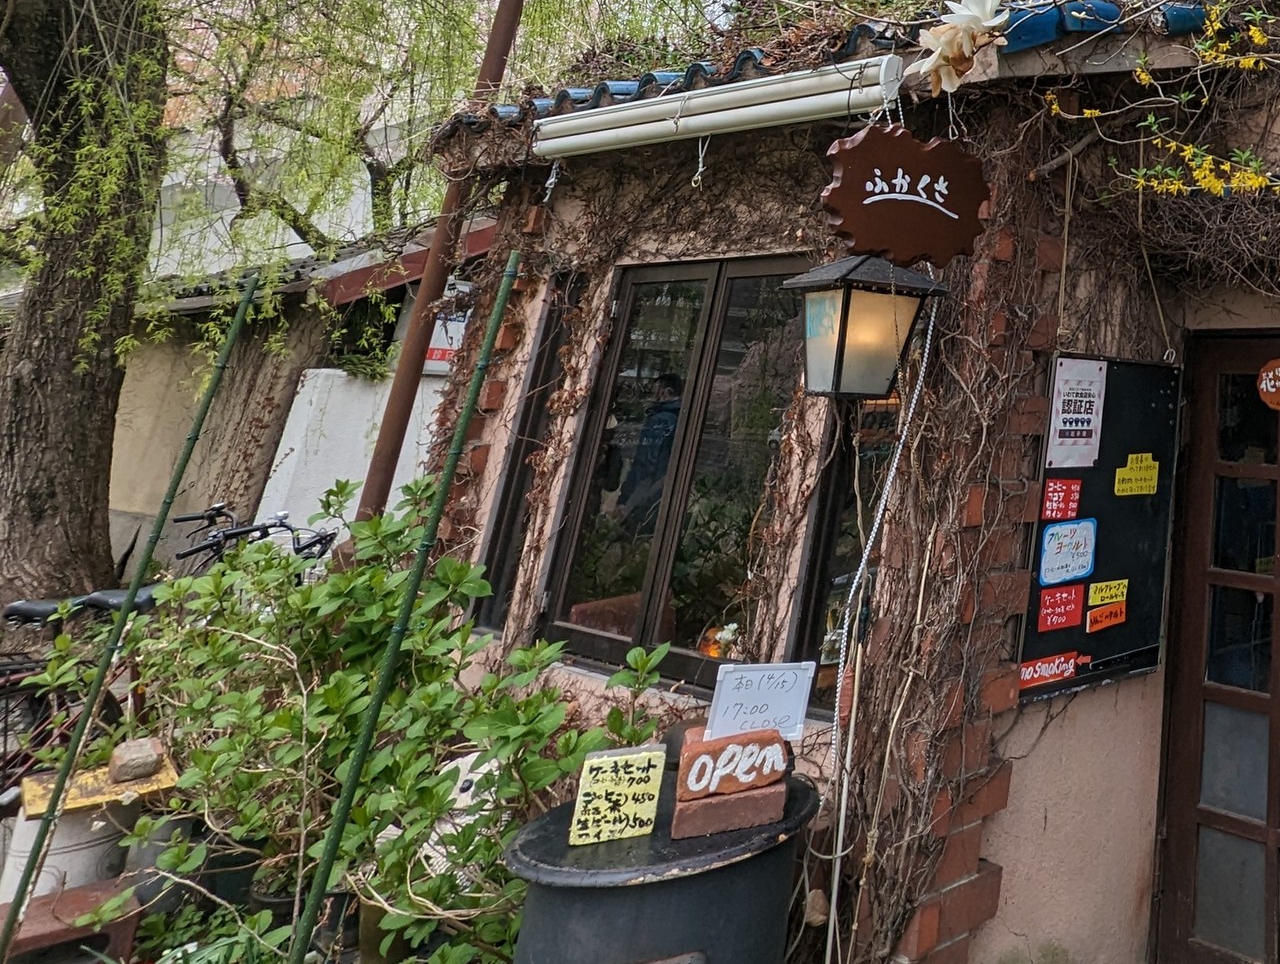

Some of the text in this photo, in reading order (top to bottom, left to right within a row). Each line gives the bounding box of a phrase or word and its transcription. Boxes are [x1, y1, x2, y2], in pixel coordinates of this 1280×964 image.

[865, 167, 949, 203] ふかくさ
[1061, 399, 1096, 415] 認証店
[1047, 528, 1077, 544] フルーツ
[1044, 588, 1077, 606] ケーキセット
[723, 702, 769, 721] 17:00
[589, 757, 658, 779] ケーキセット
[627, 775, 652, 788] 700
[632, 791, 656, 805] 450
[629, 812, 654, 829] 500
